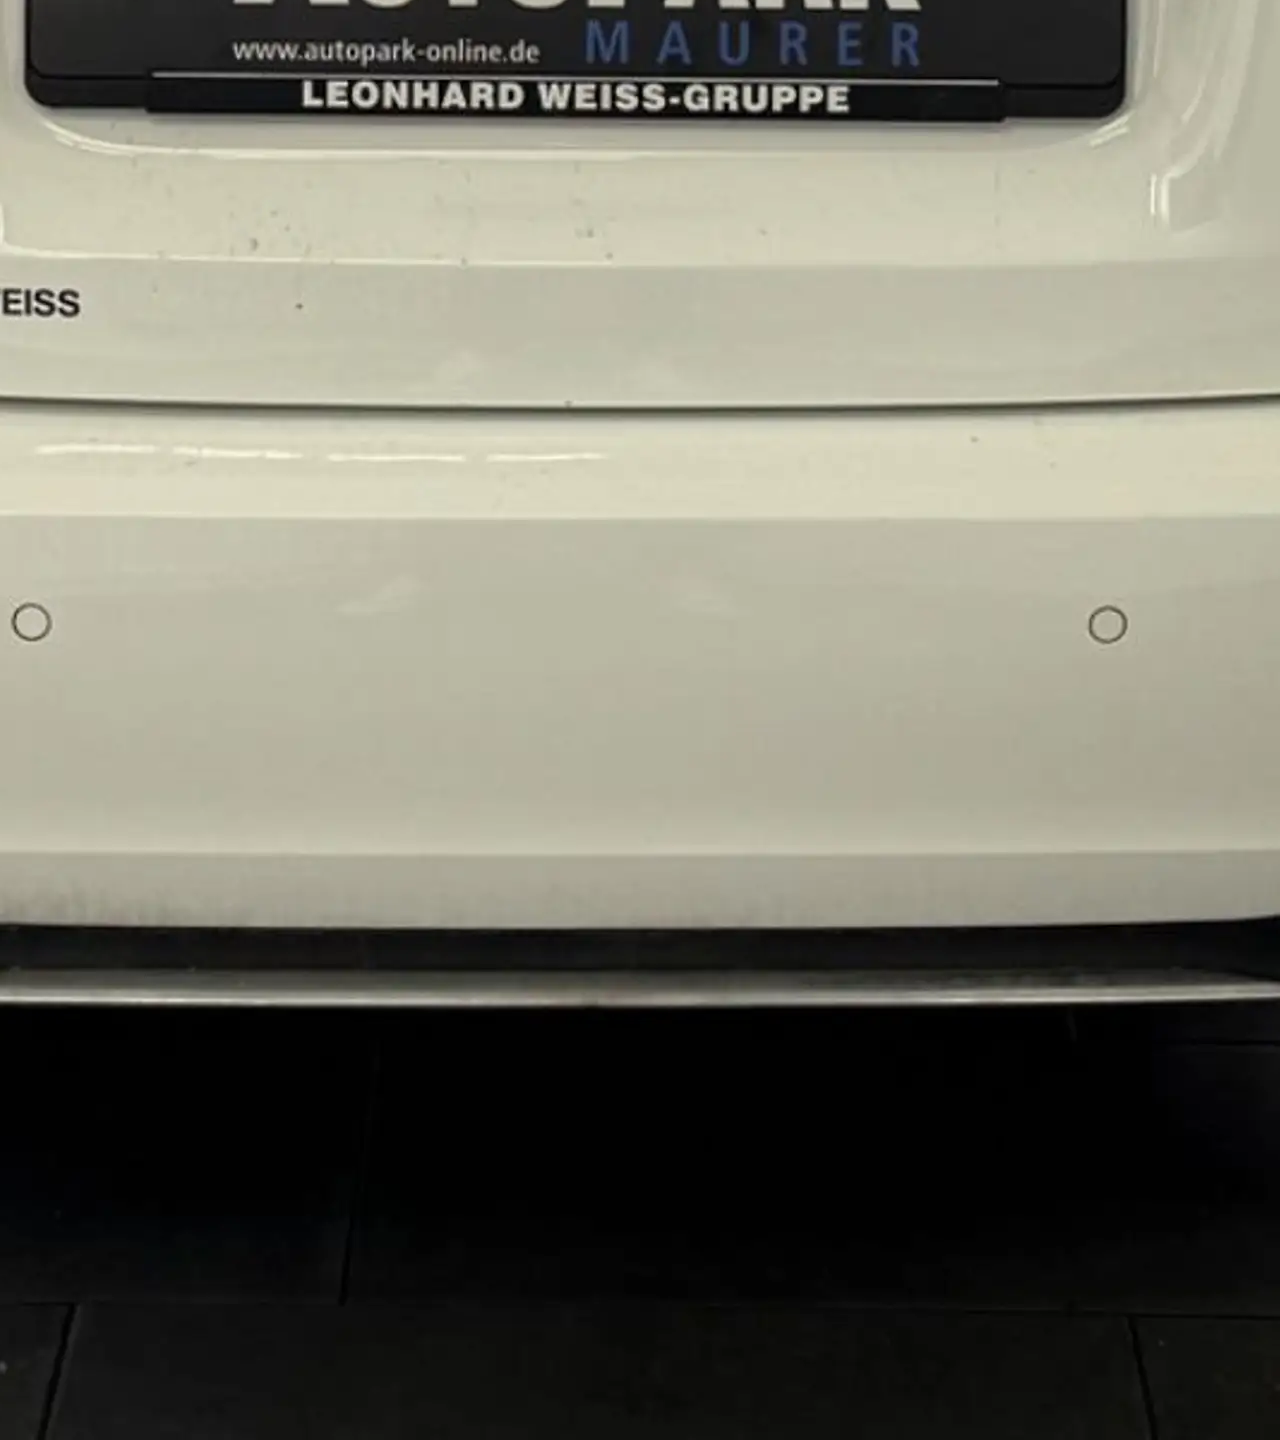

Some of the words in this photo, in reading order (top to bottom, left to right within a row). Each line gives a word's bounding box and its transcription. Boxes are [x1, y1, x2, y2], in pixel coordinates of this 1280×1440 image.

[232, 38, 541, 68] www.autopark-online.de
[585, 19, 921, 67] MAURER
[301, 79, 526, 110] LEONHARD
[537, 82, 850, 113] WEISS-GRUPPE
